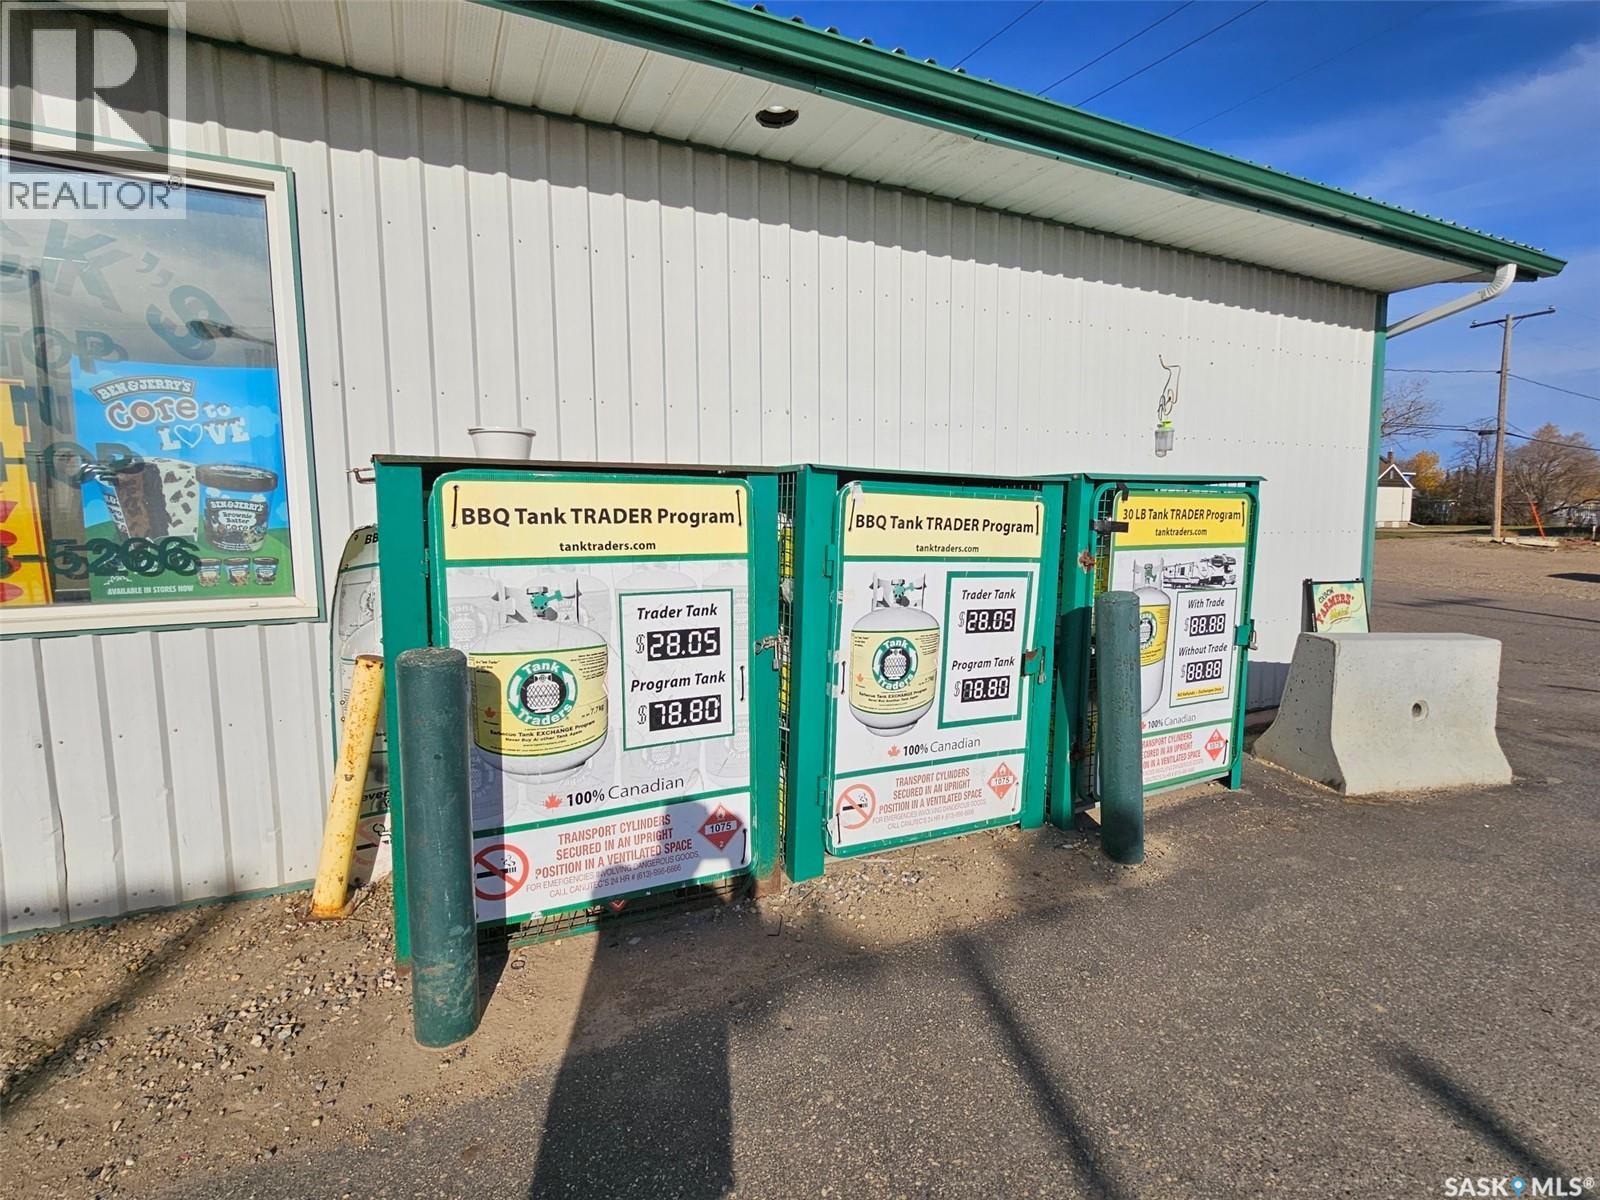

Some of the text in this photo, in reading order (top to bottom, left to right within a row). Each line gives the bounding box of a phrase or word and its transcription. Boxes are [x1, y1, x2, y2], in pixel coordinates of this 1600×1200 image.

[461, 507, 735, 528] BBQ Tank TRADER Program
[1135, 509, 1146, 520] LB
[1148, 509, 1168, 520] Tank
[1170, 509, 1205, 520] TRADER
[1206, 509, 1241, 523] Program
[856, 514, 1034, 536] BBQ Tank TRADER Program
[1155, 527, 1208, 536] tanktraders.com
[559, 541, 656, 552] tanktraders.com
[915, 544, 979, 553] tanktraders.com
[107, 587, 143, 596] AVAILABLE
[153, 586, 177, 594] STORES
[178, 585, 194, 593] NOW
[962, 588, 1017, 601] Trader Tank
[1188, 597, 1225, 609] With Trade
[637, 603, 718, 621] Trader Tank
[882, 639, 909, 650] Tank
[1178, 643, 1228, 657] Without Trade
[521, 661, 561, 675] Tank
[951, 656, 1016, 672] Program Tank
[630, 670, 727, 693] Program Tank
[878, 673, 914, 691] Traders
[517, 703, 573, 726] Traders
[903, 736, 981, 756] 100% Canadian
[896, 767, 970, 787] TRANSPORT CYLINDERS
[567, 789, 605, 807] 100%
[608, 776, 685, 800] Canadian
[893, 779, 971, 801] SECURED IN AN UPRIGHT
[879, 800, 910, 815] POSITION
[926, 791, 962, 807] VENTILATED
[963, 789, 983, 799] SPACE
[558, 814, 671, 846] TRANSPORT CYLINDERS
[709, 822, 732, 834] 1075
[556, 828, 674, 861] SECURED IN AN UPRIGHT
[535, 839, 693, 879] POSITION IN A VENTILATED SPACE
[526, 881, 542, 892] FOR
[621, 874, 631, 884] HR
